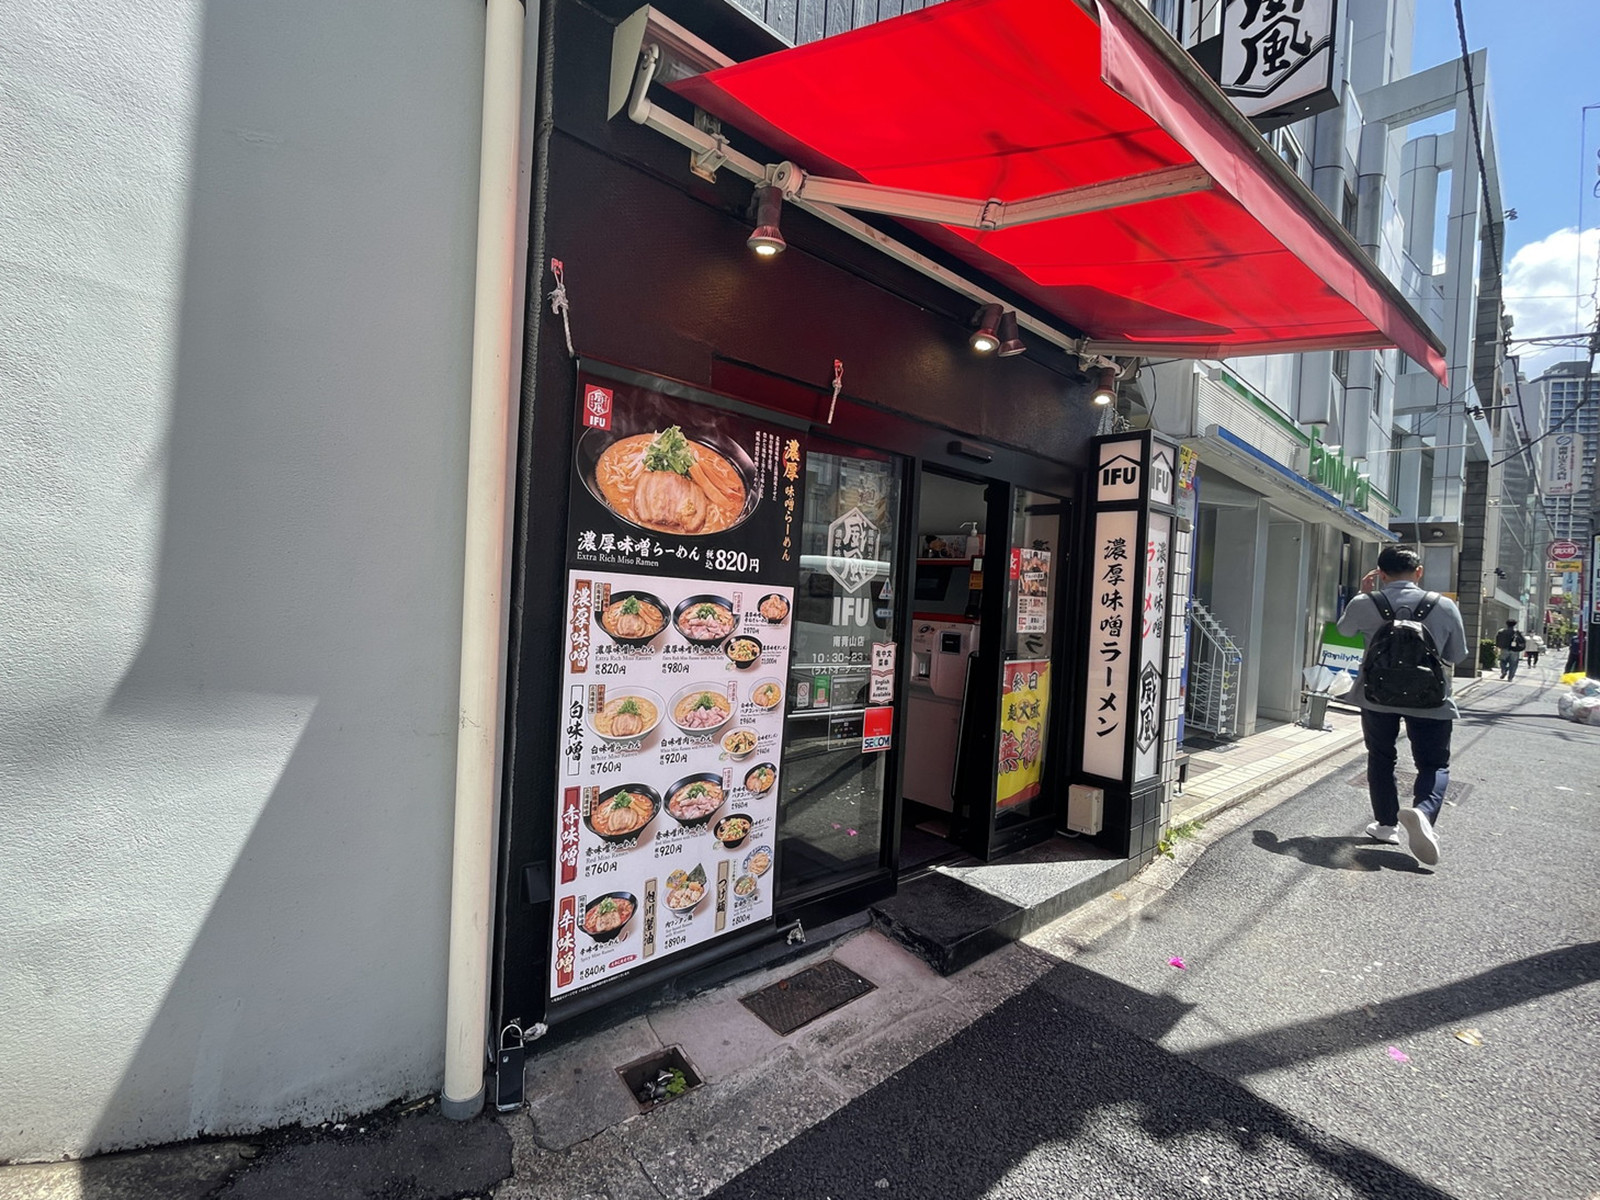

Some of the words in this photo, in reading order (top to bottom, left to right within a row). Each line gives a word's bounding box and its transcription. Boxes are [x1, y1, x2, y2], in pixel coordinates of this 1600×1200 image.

[590, 416, 606, 427] IFU
[1102, 467, 1137, 486] IFU
[1151, 467, 1169, 494] IFU
[577, 530, 700, 561] 濃厚味噌らーめん
[577, 551, 597, 561] Extra
[599, 553, 616, 563] Rich
[617, 555, 634, 564] Miso
[635, 557, 659, 567] Ramen
[1152, 542, 1167, 638] 濃厚味噌
[569, 586, 593, 667] 濃厚味噌
[832, 597, 870, 627] IFU
[832, 635, 865, 647] 南青山店
[1096, 537, 1128, 738] 濃厚味噌ラーメン
[565, 700, 584, 761] 白味噌
[864, 736, 890, 748] SECOM
[561, 803, 581, 867] 赤味噌
[556, 909, 576, 974] 辛味噌
